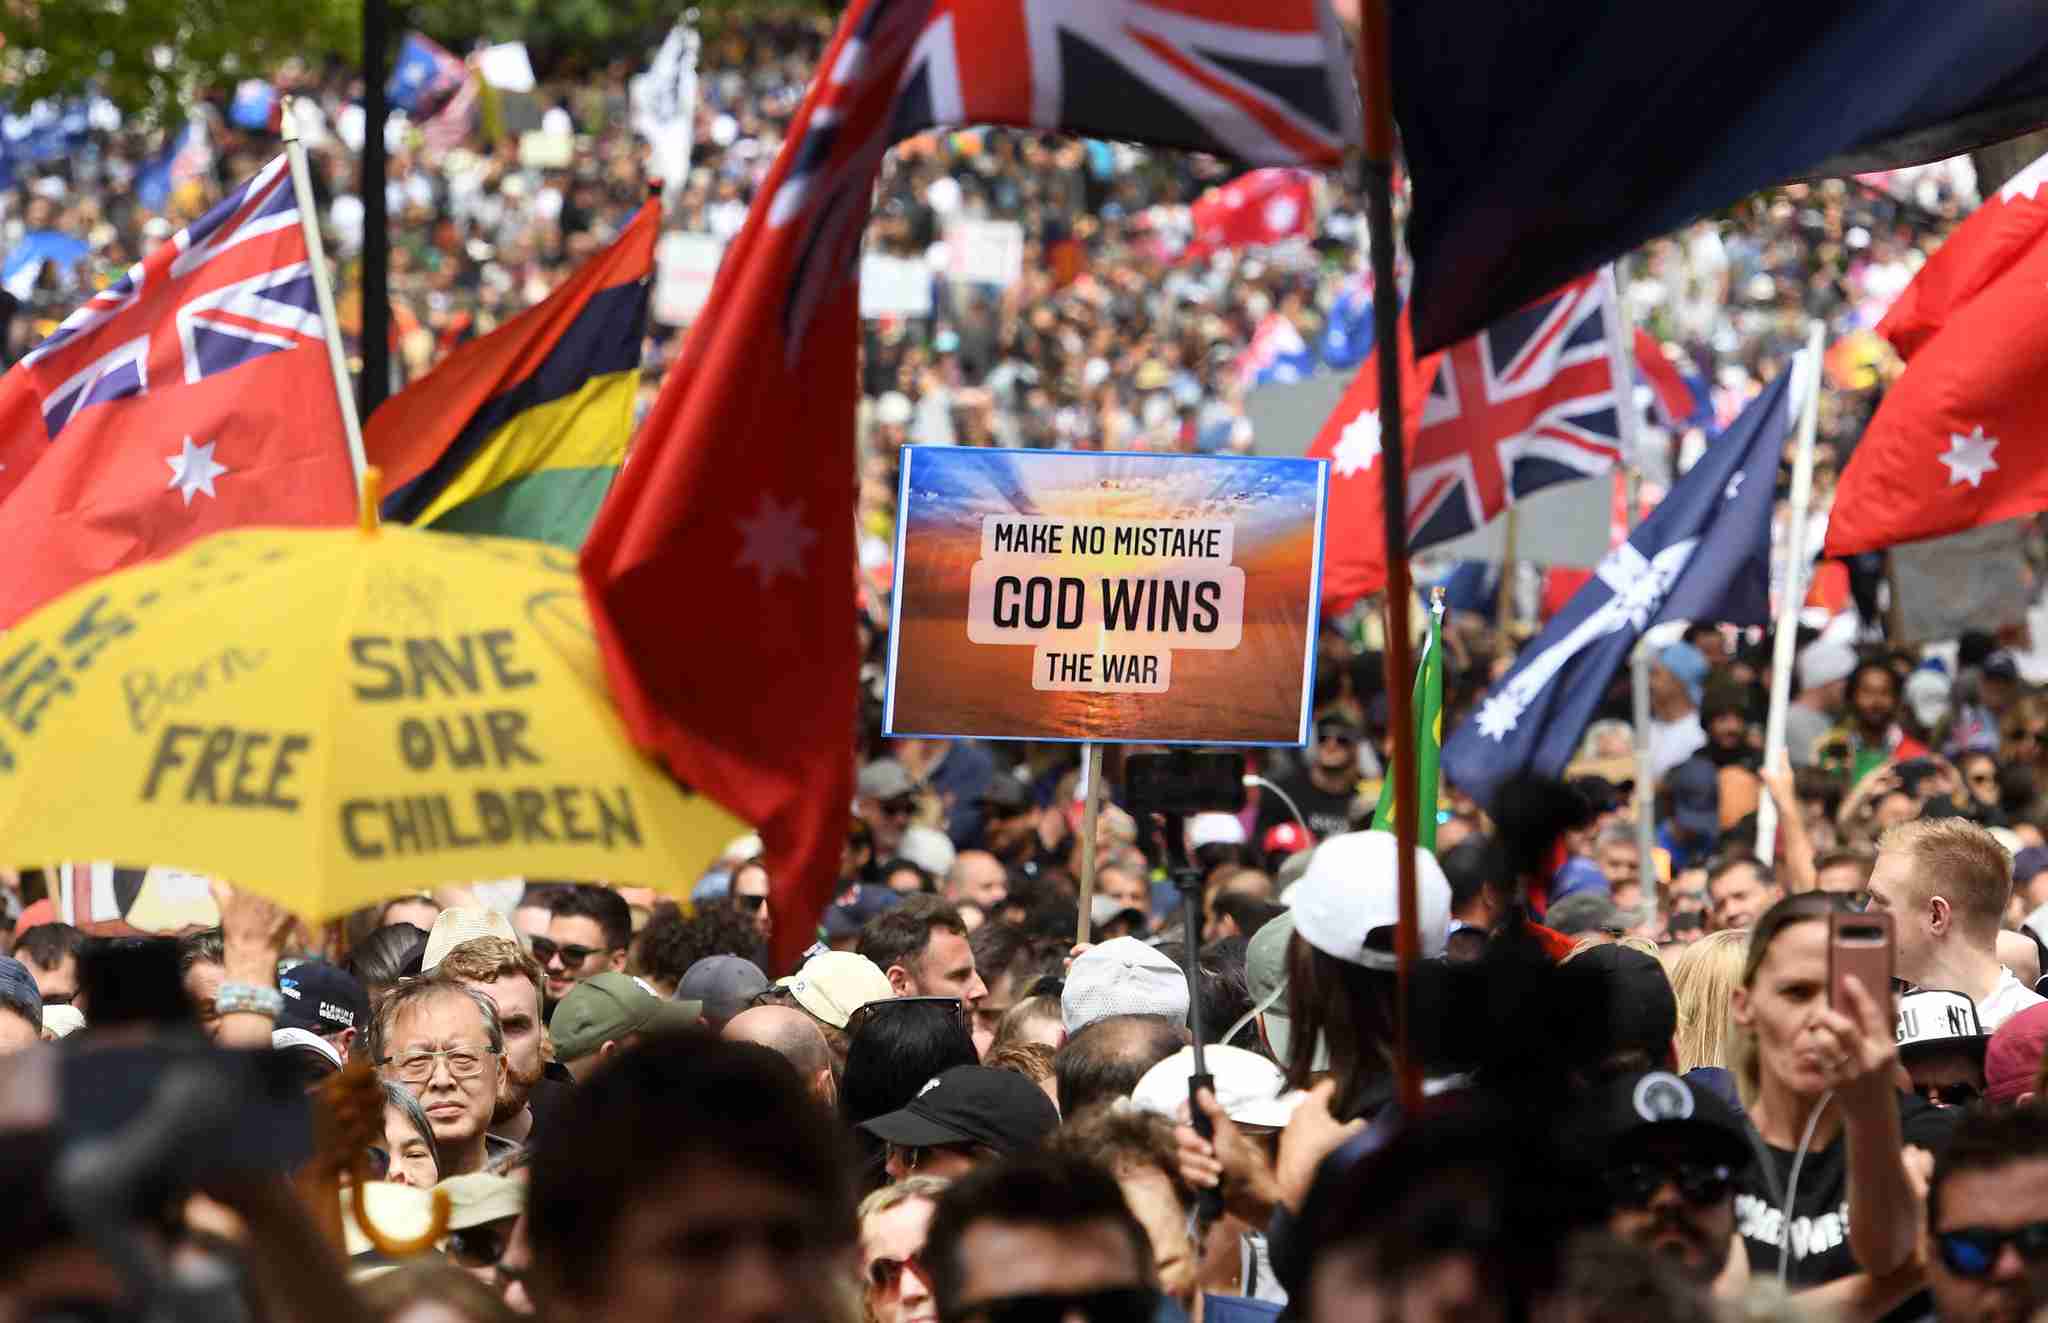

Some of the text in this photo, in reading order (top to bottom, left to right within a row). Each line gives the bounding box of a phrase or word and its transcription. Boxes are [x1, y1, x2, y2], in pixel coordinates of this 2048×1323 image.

[995, 523, 1221, 558] MAKE NO MISTAKE
[993, 576, 1222, 633] GOD WINS
[349, 628, 538, 701] SAVE
[1046, 653, 1159, 684] THE WAR
[140, 724, 312, 812] FREE
[398, 708, 543, 771] OUR
[339, 785, 646, 861] CHILDREN
